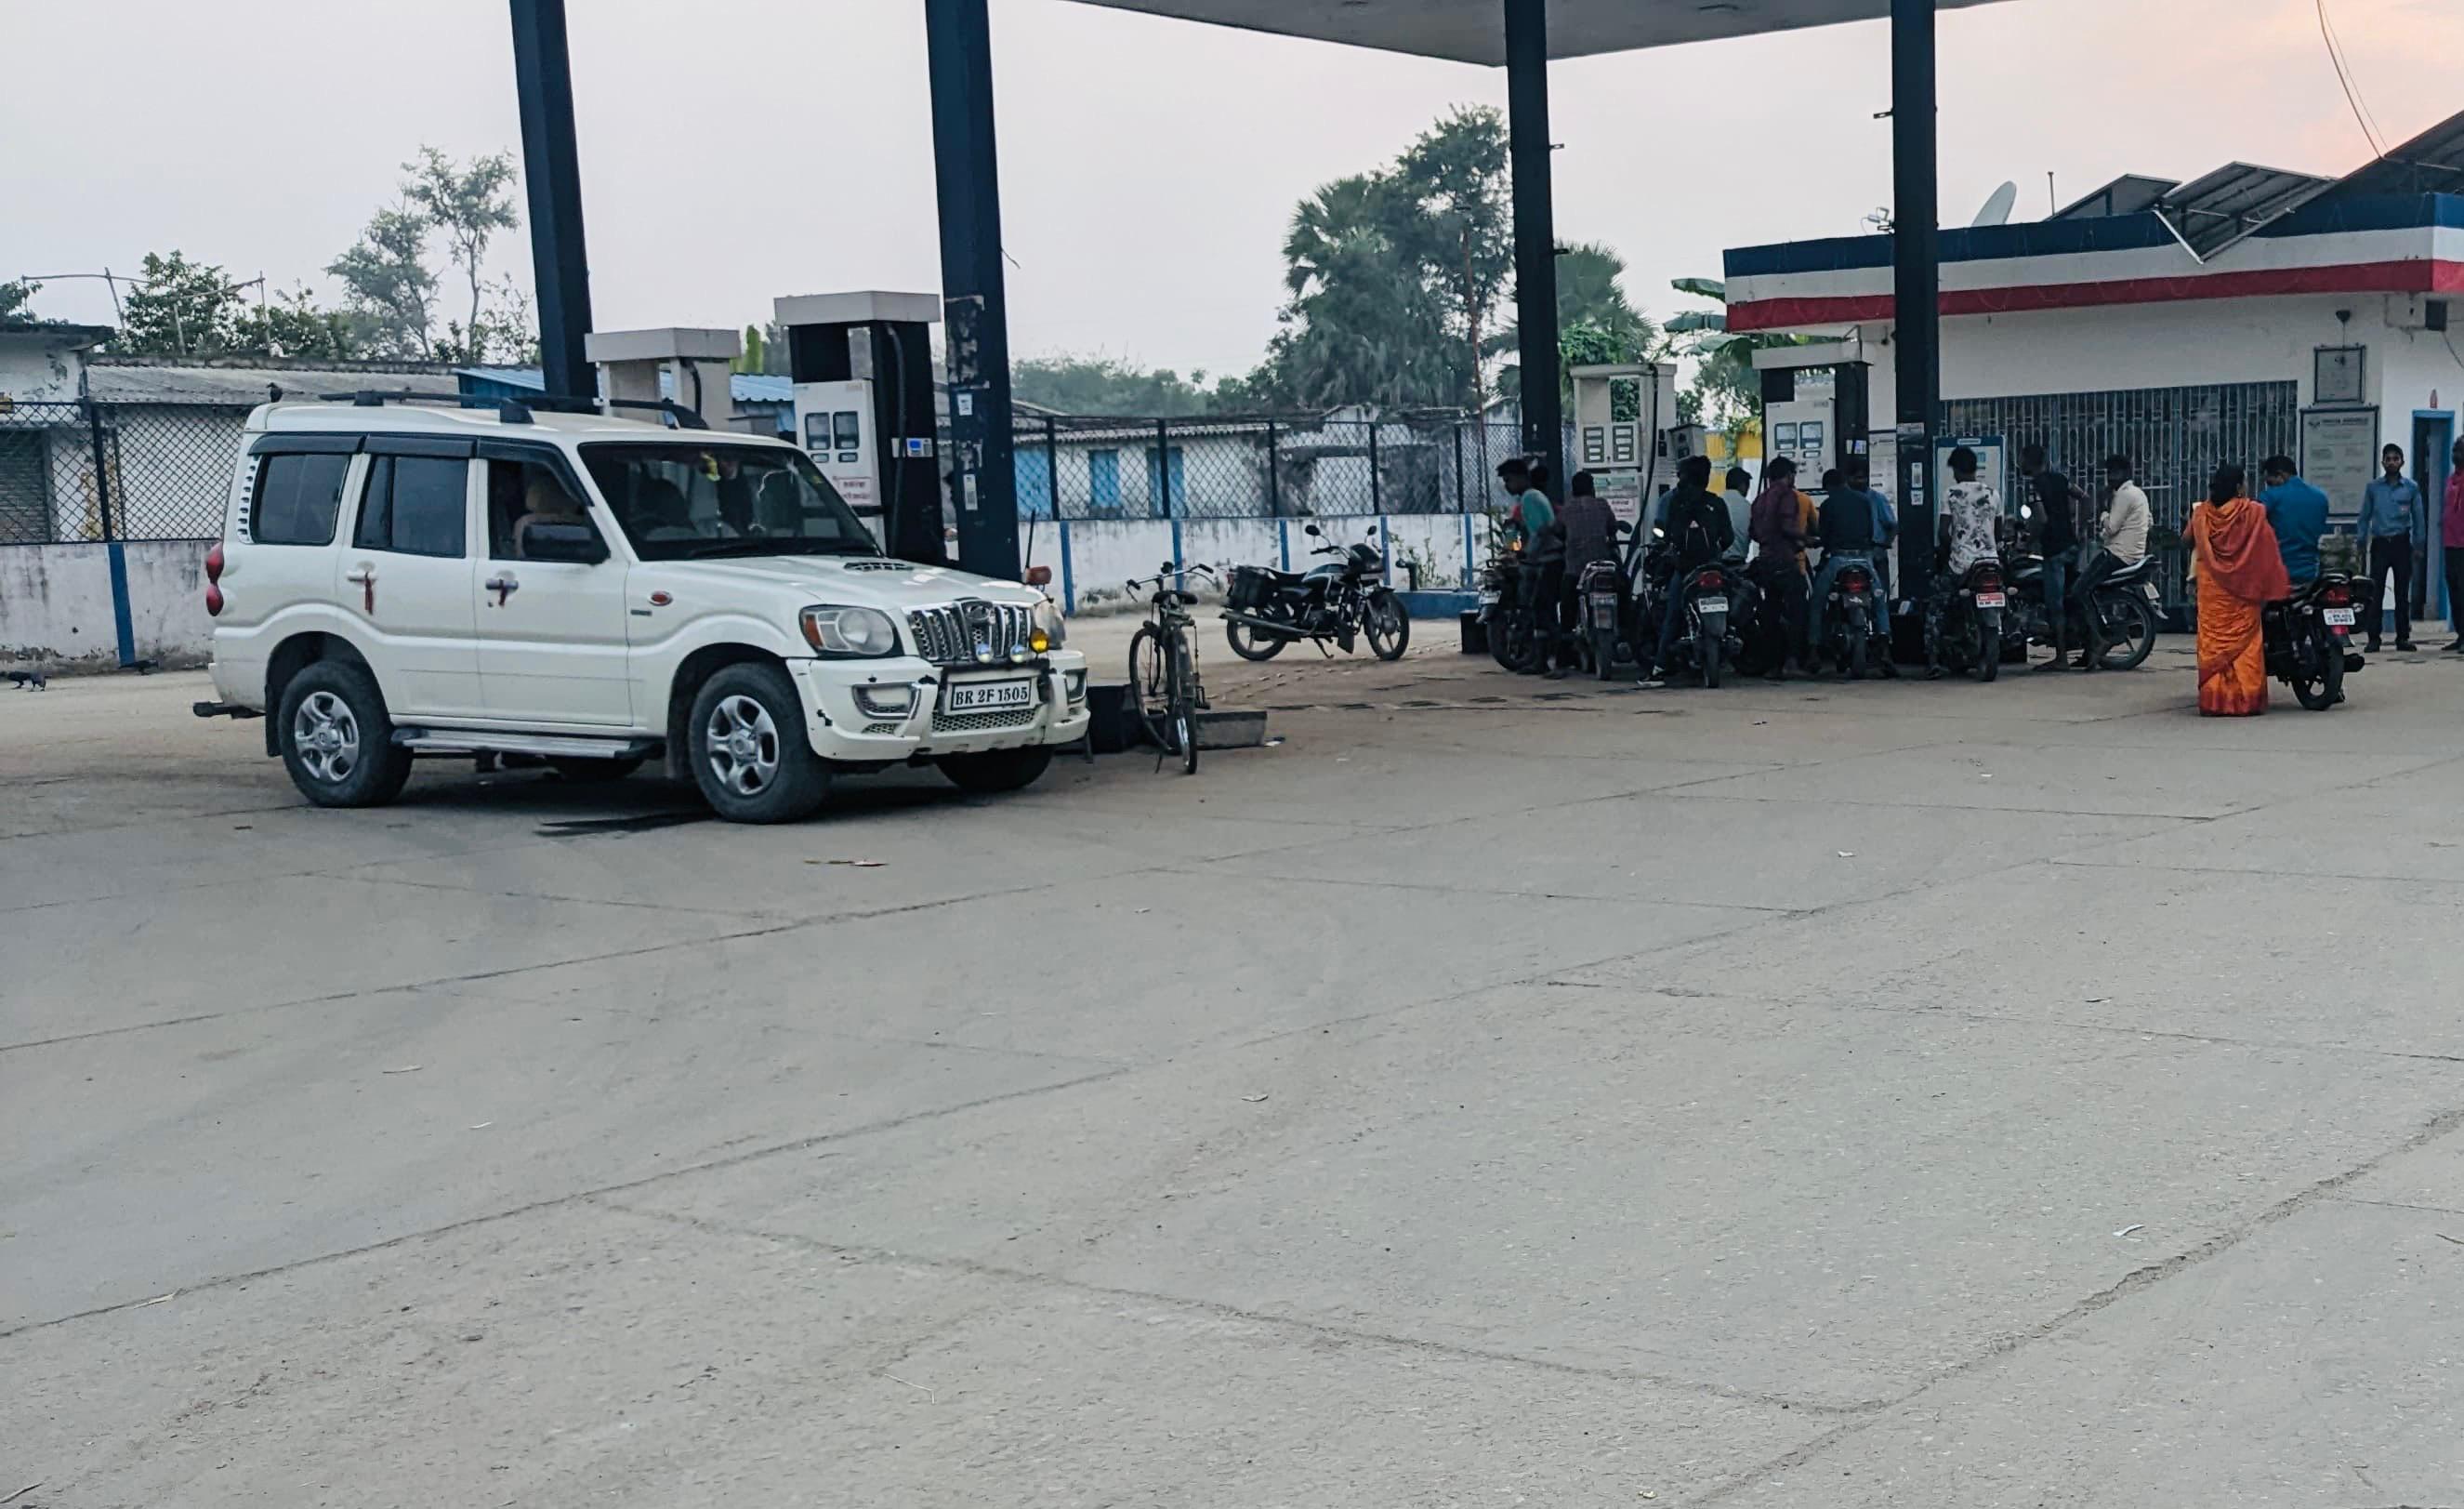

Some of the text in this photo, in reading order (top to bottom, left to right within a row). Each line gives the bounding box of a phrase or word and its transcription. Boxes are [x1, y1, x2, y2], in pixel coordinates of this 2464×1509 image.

[955, 686, 1028, 705] BR 2F 1505
